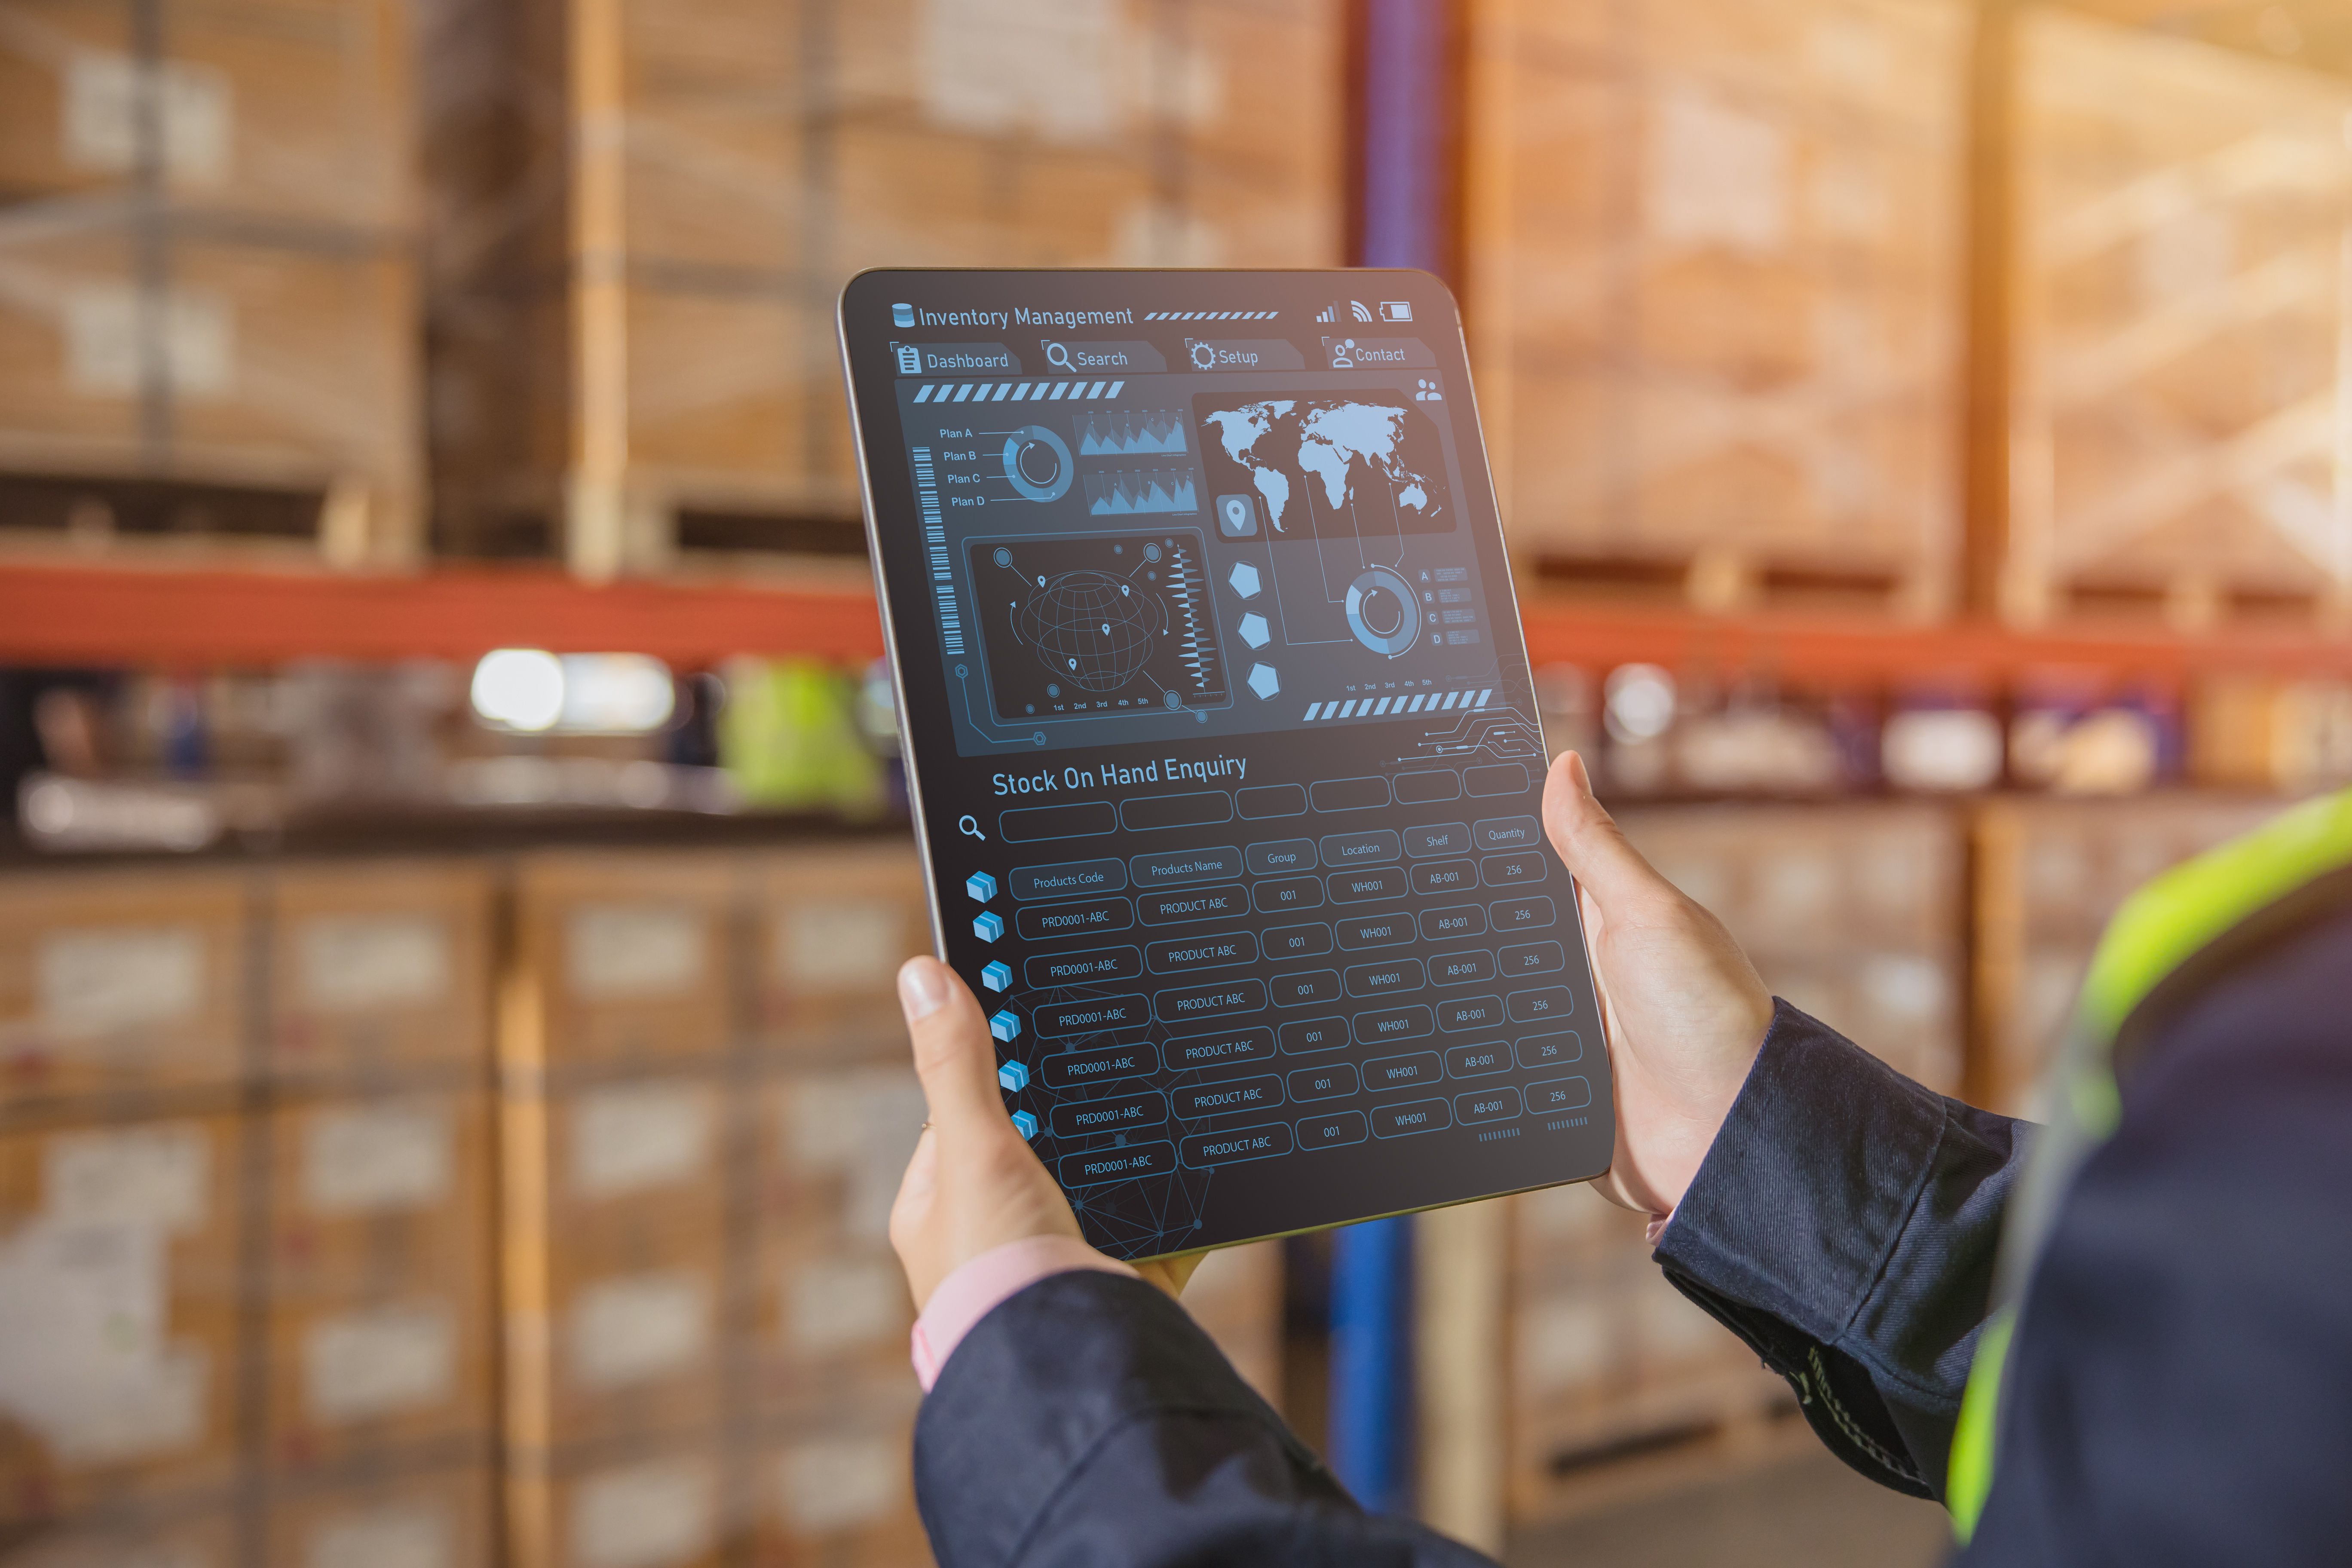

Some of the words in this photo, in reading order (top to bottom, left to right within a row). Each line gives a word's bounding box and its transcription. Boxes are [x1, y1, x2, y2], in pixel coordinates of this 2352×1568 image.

[920, 308, 1008, 329] Inventory
[1015, 308, 1133, 328] Management
[928, 353, 1008, 368] Dashboard
[1078, 352, 1127, 365] Search
[1219, 350, 1258, 366] Setup
[1356, 348, 1405, 361] Contact
[940, 429, 962, 438] Plan
[965, 429, 972, 437] A
[944, 452, 966, 460] Plan
[969, 451, 976, 459] B
[948, 475, 970, 483] Plan
[973, 474, 980, 482] C
[952, 497, 974, 506] Plan
[977, 496, 984, 505] D
[1430, 614, 1436, 622] C
[993, 770, 1058, 795] Stock
[1065, 768, 1093, 788] On
[1101, 760, 1158, 785] Hand
[1165, 755, 1246, 782] Enquiry
[1427, 835, 1448, 846] Shelf
[1489, 829, 1524, 840] Quantity
[1342, 844, 1380, 855] Location
[1268, 854, 1295, 864] Group
[1152, 864, 1192, 876] Products
[1195, 861, 1222, 871] Name
[1507, 865, 1521, 875] 256
[1034, 876, 1076, 888] Products
[1079, 872, 1103, 883] Code
[1431, 872, 1458, 883] AB-001
[1352, 881, 1382, 892] WH001
[1281, 891, 1295, 900] 001
[1161, 900, 1206, 914] PRODUCT
[1210, 898, 1228, 909] ABC
[1042, 911, 1109, 928] PRD0001-ABC
[1515, 910, 1530, 919] 256
[1439, 918, 1467, 929] AB-001
[1360, 927, 1391, 938] WH001
[1289, 937, 1304, 947] 001
[1169, 947, 1214, 962] PRODUCT
[1218, 945, 1236, 956] ABC
[1524, 956, 1539, 965] 256
[1051, 959, 1118, 977] PRD0001-ABC
[1448, 963, 1476, 975] AB-001
[1369, 973, 1400, 985] WH001
[1298, 984, 1313, 995] 001
[1178, 995, 1223, 1011] PRODUCT
[1227, 993, 1245, 1004] ABC
[1533, 1000, 1547, 1010] 256
[1060, 1008, 1126, 1026] PRD0001-ABC
[1457, 1009, 1485, 1021] AB-001
[1378, 1020, 1408, 1032] WH001
[1307, 1032, 1322, 1042] 001
[1186, 1044, 1231, 1059] PRODUCT
[1235, 1041, 1253, 1052] ABC
[1541, 1046, 1556, 1056] 256
[1068, 1057, 1135, 1075] PRD0001-ABC
[1466, 1055, 1494, 1067] AB-001
[1387, 1066, 1417, 1078] WH001
[1316, 1079, 1330, 1089] 001
[1195, 1092, 1240, 1107] PRODUCT
[1244, 1089, 1262, 1100] ABC
[1550, 1091, 1565, 1101] 256
[1475, 1101, 1502, 1114] AB-001
[1076, 1106, 1143, 1125] PRD0001-ABC
[1395, 1113, 1426, 1125] WH001
[1324, 1126, 1339, 1137] 001
[1204, 1140, 1249, 1156] PRODUCT
[1253, 1137, 1271, 1148] ABC
[1085, 1155, 1152, 1175] PRD0001-ABC
